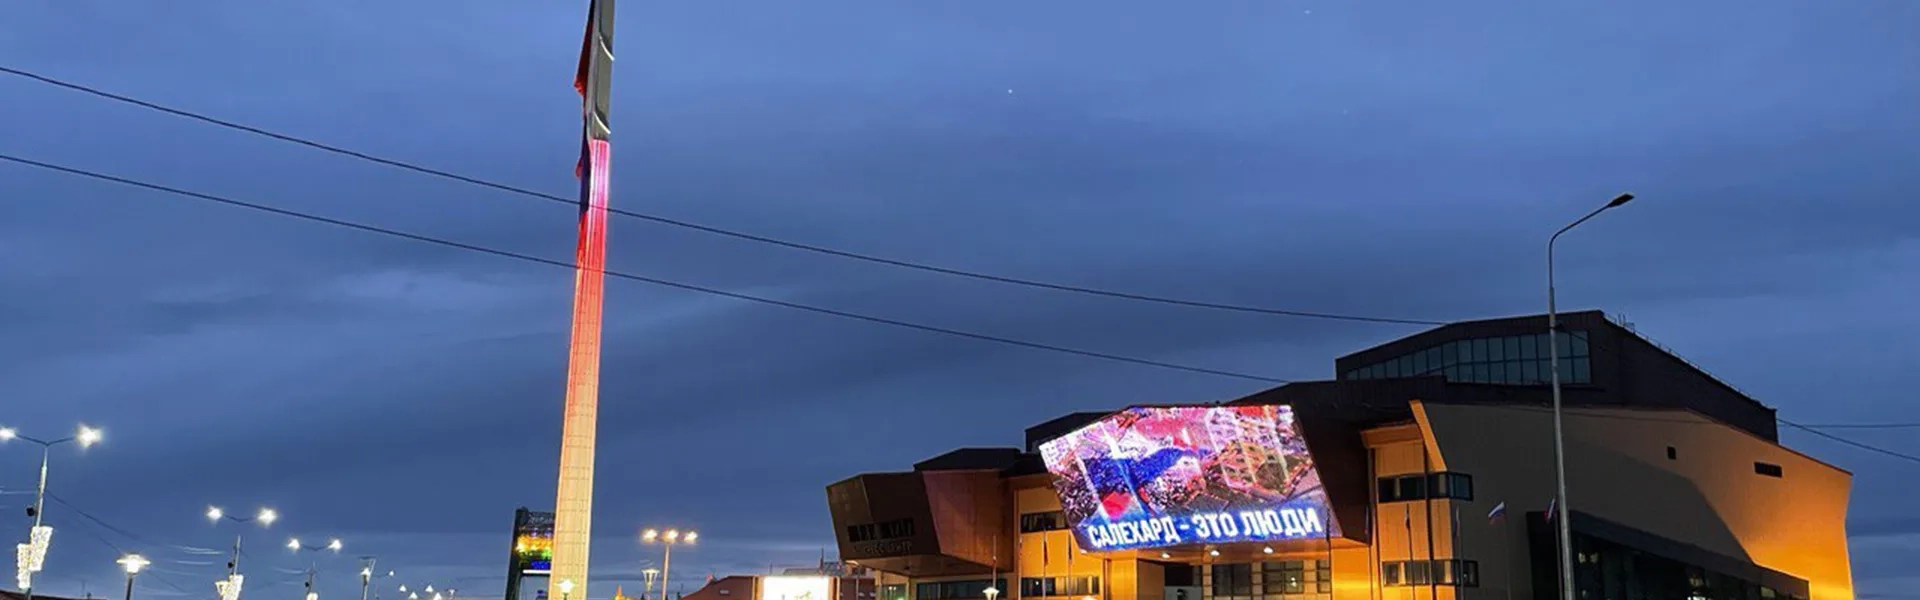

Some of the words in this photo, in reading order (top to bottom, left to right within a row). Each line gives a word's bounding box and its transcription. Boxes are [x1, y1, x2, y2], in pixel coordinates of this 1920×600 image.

[1087, 516, 1181, 547] САЛЕХАРД
[1193, 511, 1237, 537] ЭТО
[1243, 507, 1322, 535] ЛЮДИ
